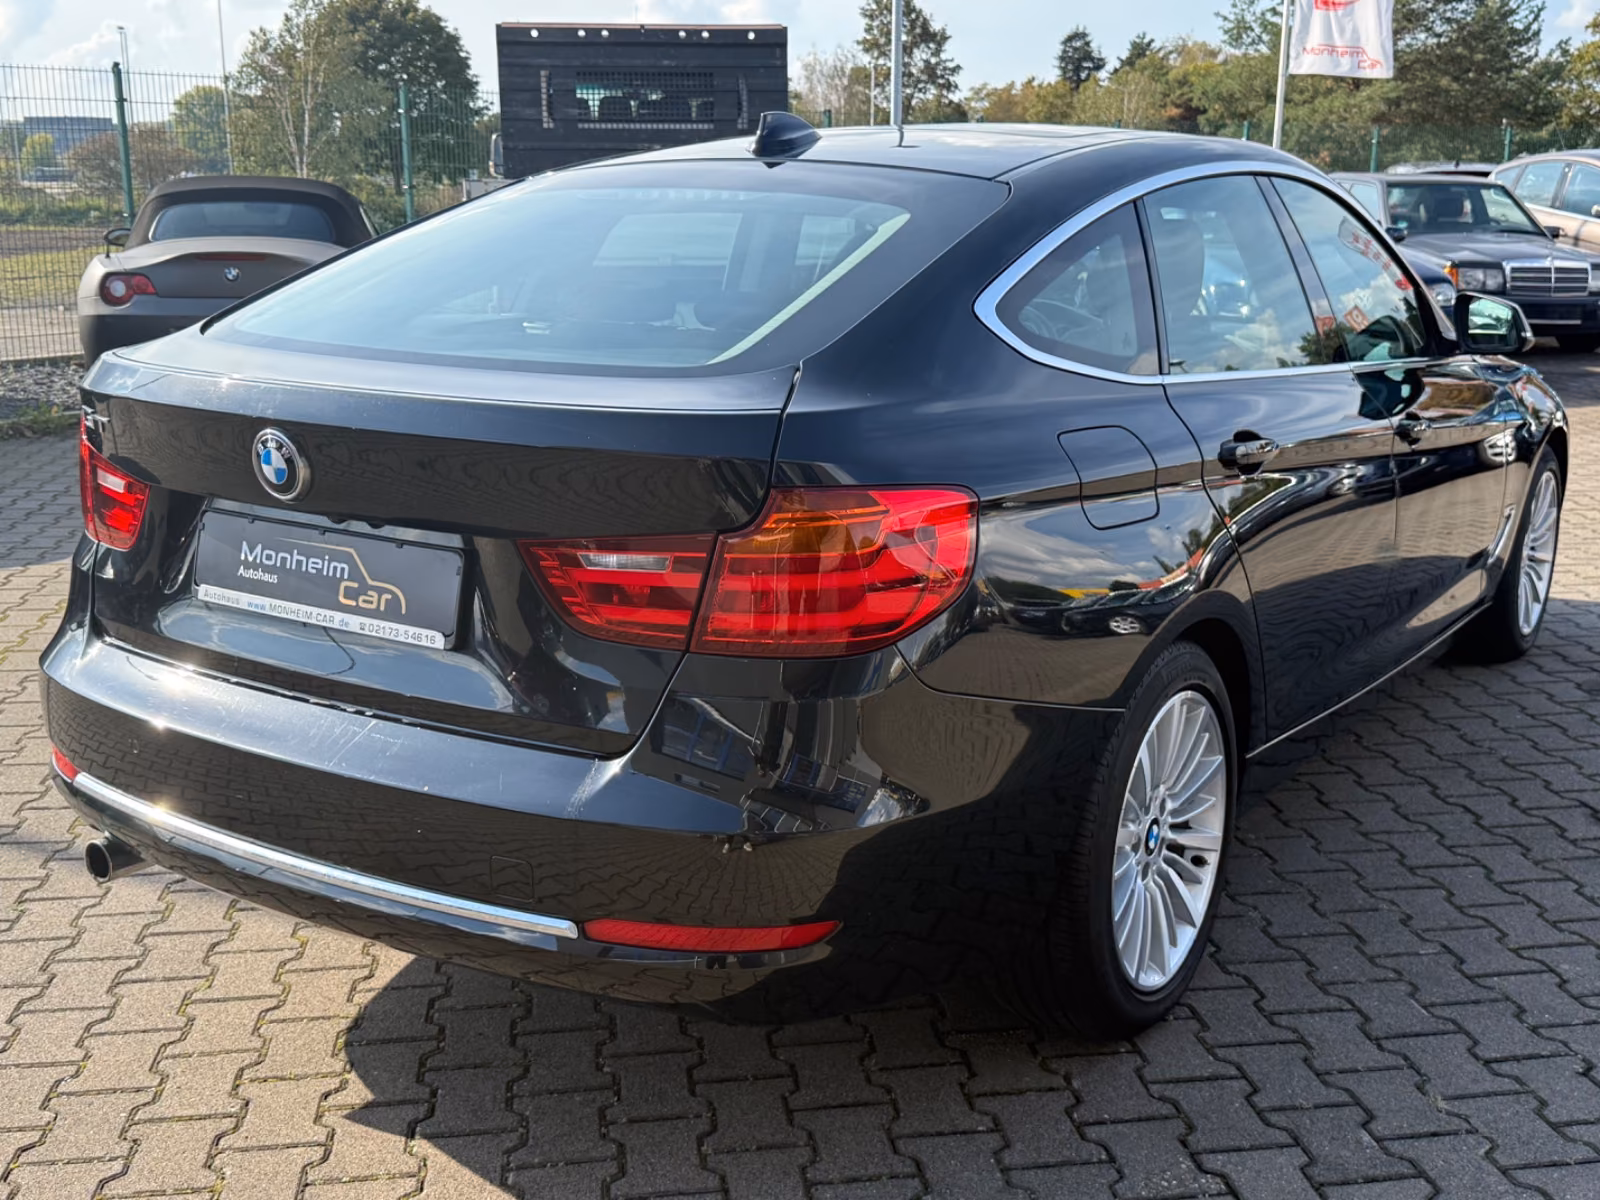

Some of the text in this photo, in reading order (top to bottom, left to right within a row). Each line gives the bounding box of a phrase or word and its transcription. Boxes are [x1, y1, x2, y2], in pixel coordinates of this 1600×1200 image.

[240, 541, 350, 579] Monheim
[237, 565, 278, 584] Autohaus
[203, 588, 241, 606] Autohaus
[338, 581, 392, 612] Car
